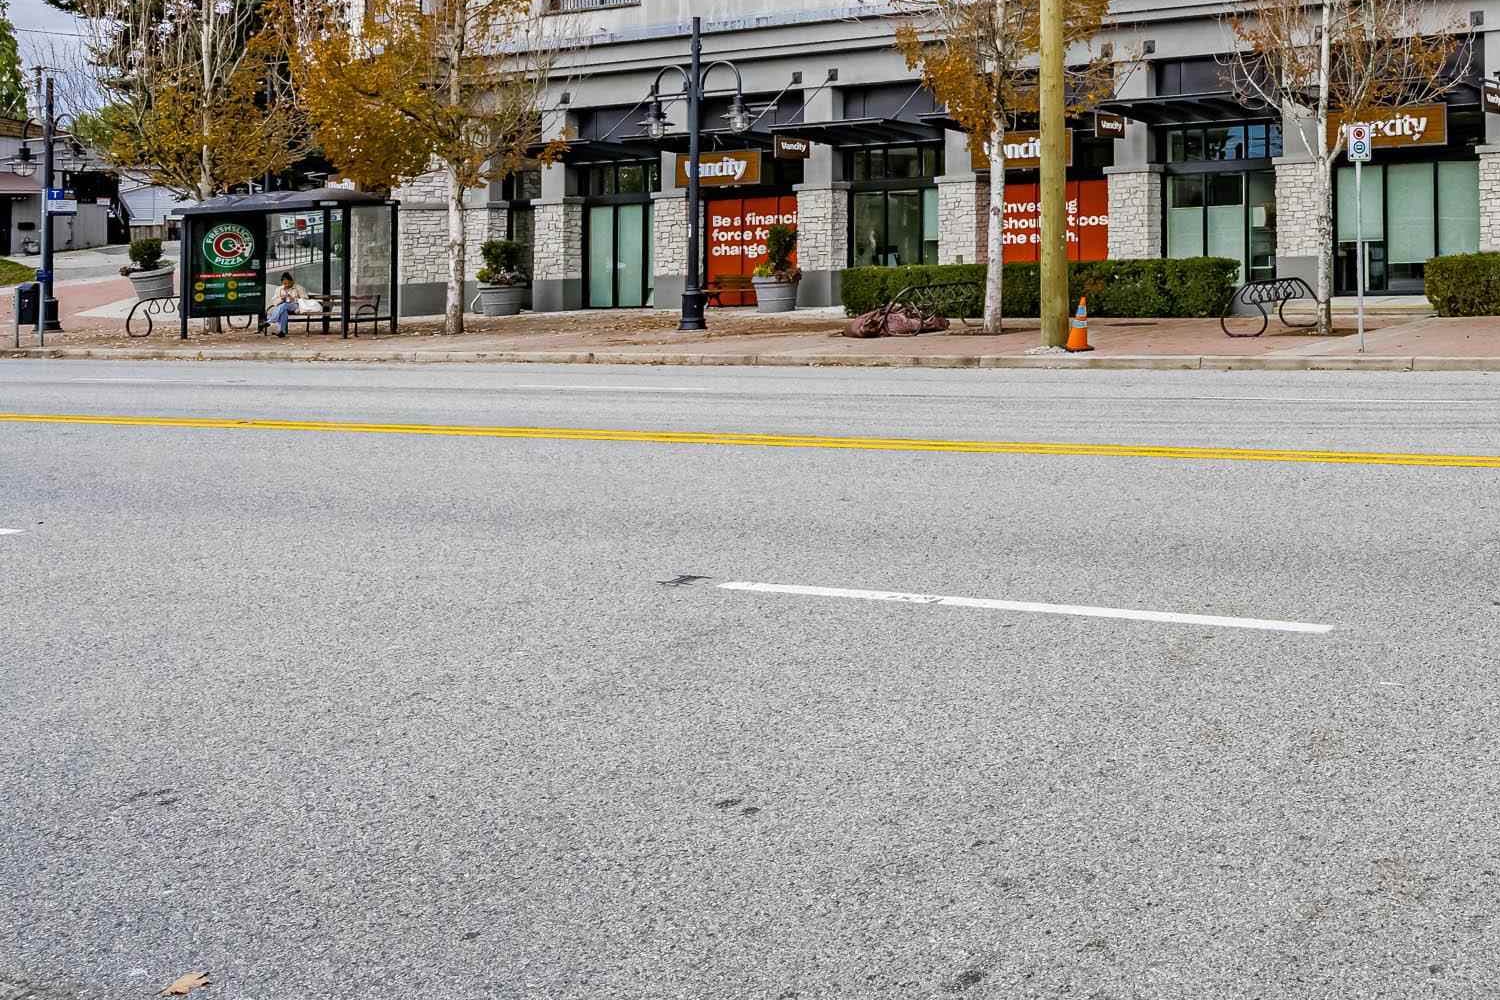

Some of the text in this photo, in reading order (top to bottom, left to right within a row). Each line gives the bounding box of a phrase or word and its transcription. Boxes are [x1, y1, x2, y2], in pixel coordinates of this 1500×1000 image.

[1101, 120, 1123, 132] Vancity
[1341, 113, 1428, 141] ncity
[781, 141, 807, 153] Vancity
[712, 211, 797, 228] Be a financi
[1077, 215, 1108, 227] cos
[712, 227, 770, 242] force fo
[1002, 232, 1027, 245] the
[215, 256, 243, 265] PIZZA
